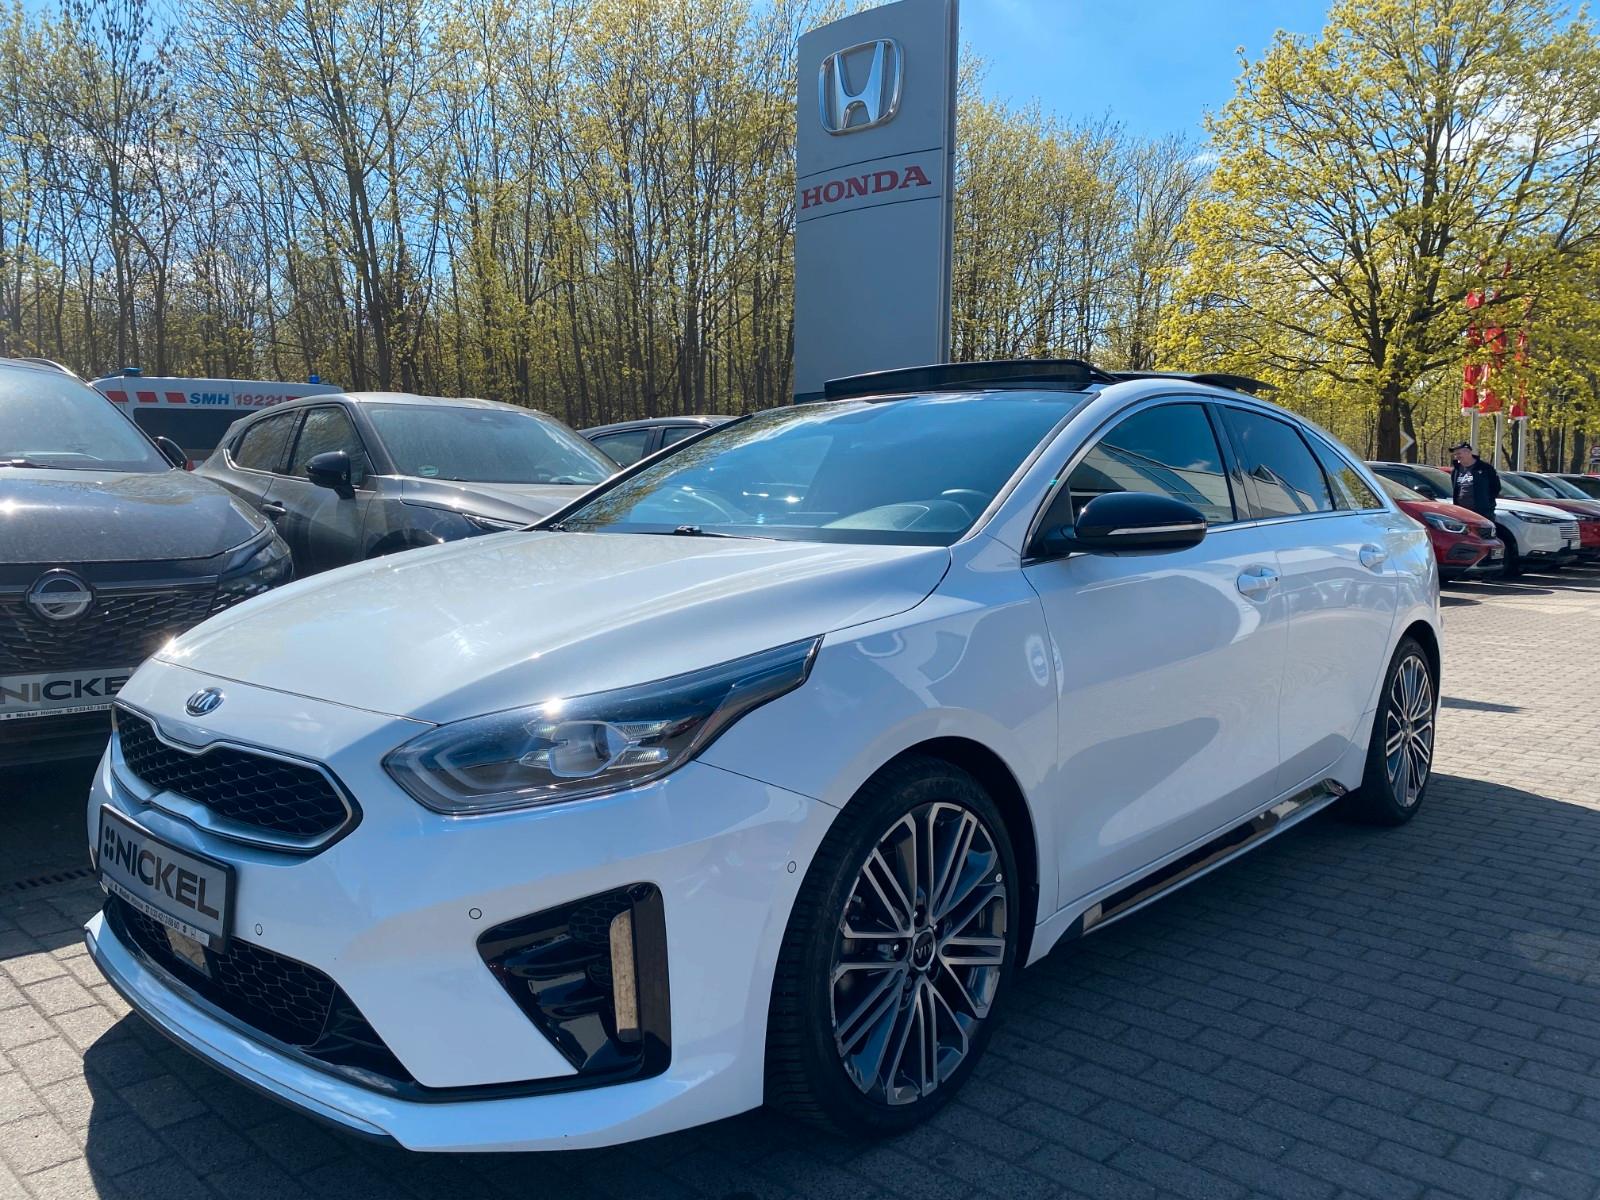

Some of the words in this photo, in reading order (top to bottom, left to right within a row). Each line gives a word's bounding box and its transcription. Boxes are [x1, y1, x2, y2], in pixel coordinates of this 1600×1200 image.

[801, 166, 931, 209] HONDA
[190, 392, 229, 405] SMH
[235, 393, 283, 406] 19221
[0, 676, 130, 705] NICKE
[115, 832, 219, 921] NICKEL
